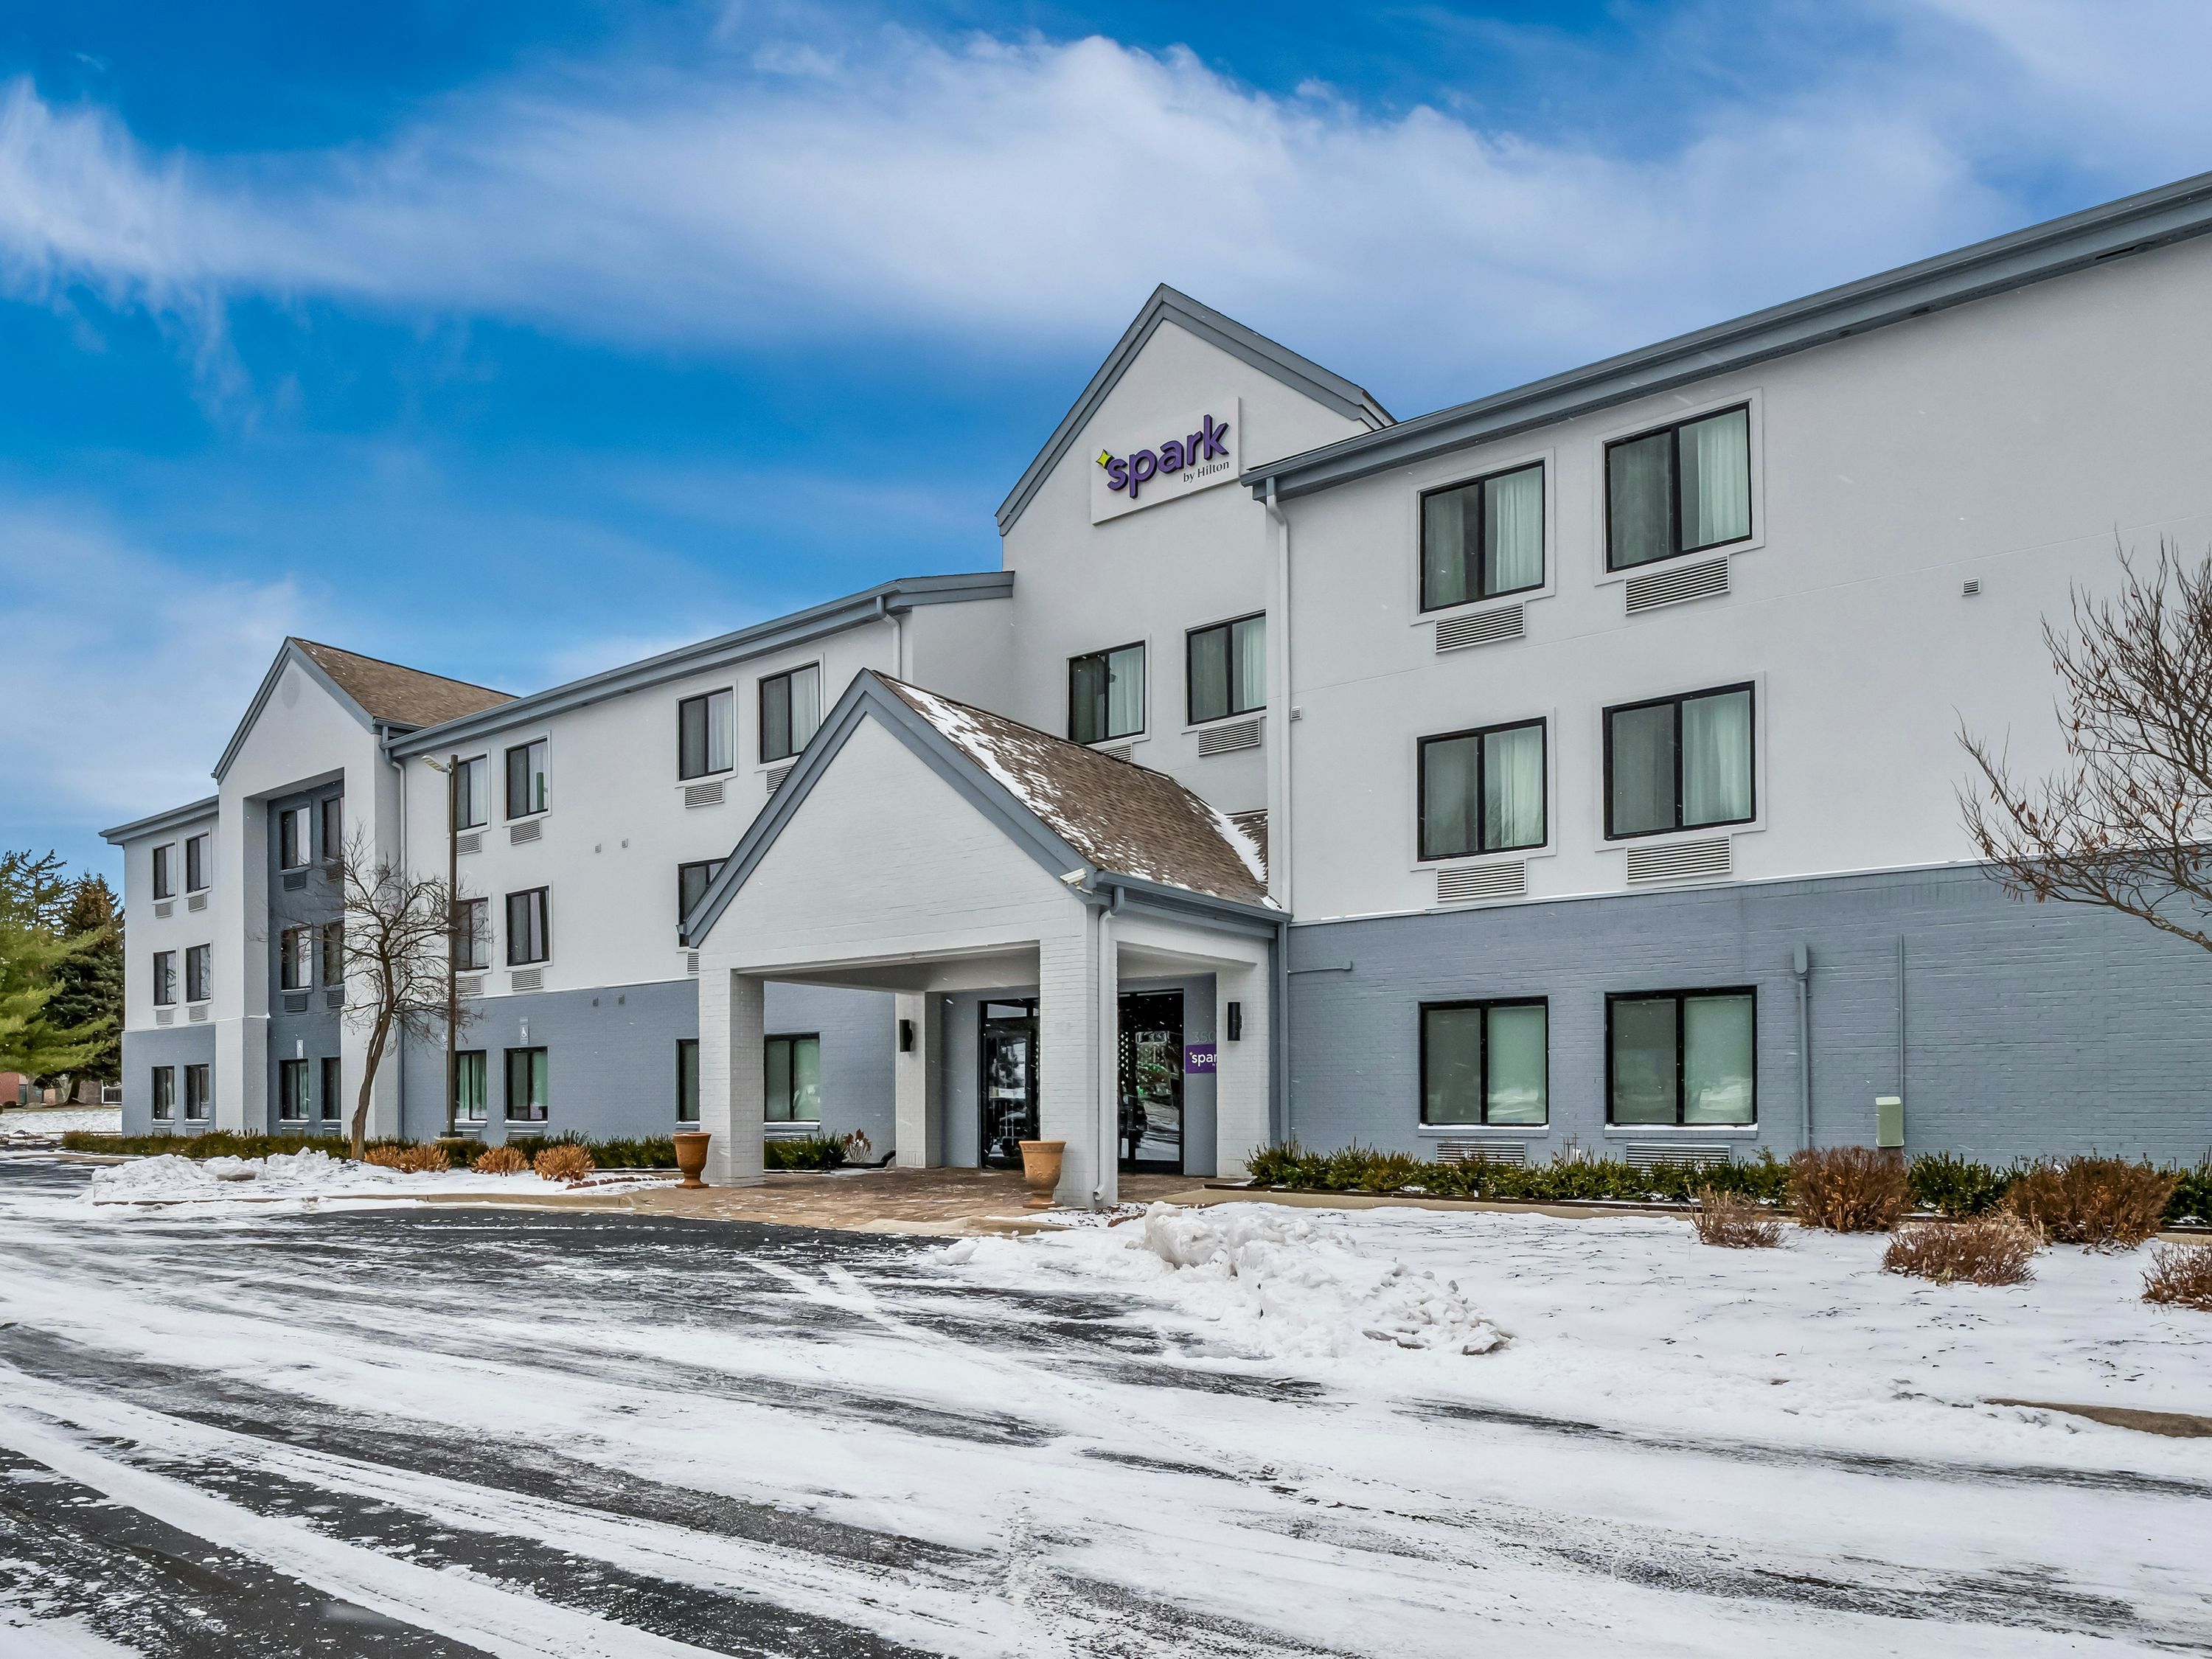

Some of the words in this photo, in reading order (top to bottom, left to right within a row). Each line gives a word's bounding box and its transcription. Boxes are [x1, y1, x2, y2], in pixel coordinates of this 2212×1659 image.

[1107, 414, 1229, 499] spark
[1183, 473, 1195, 484] by
[1197, 462, 1229, 478] Hilton
[1192, 1054, 1217, 1067] spar
